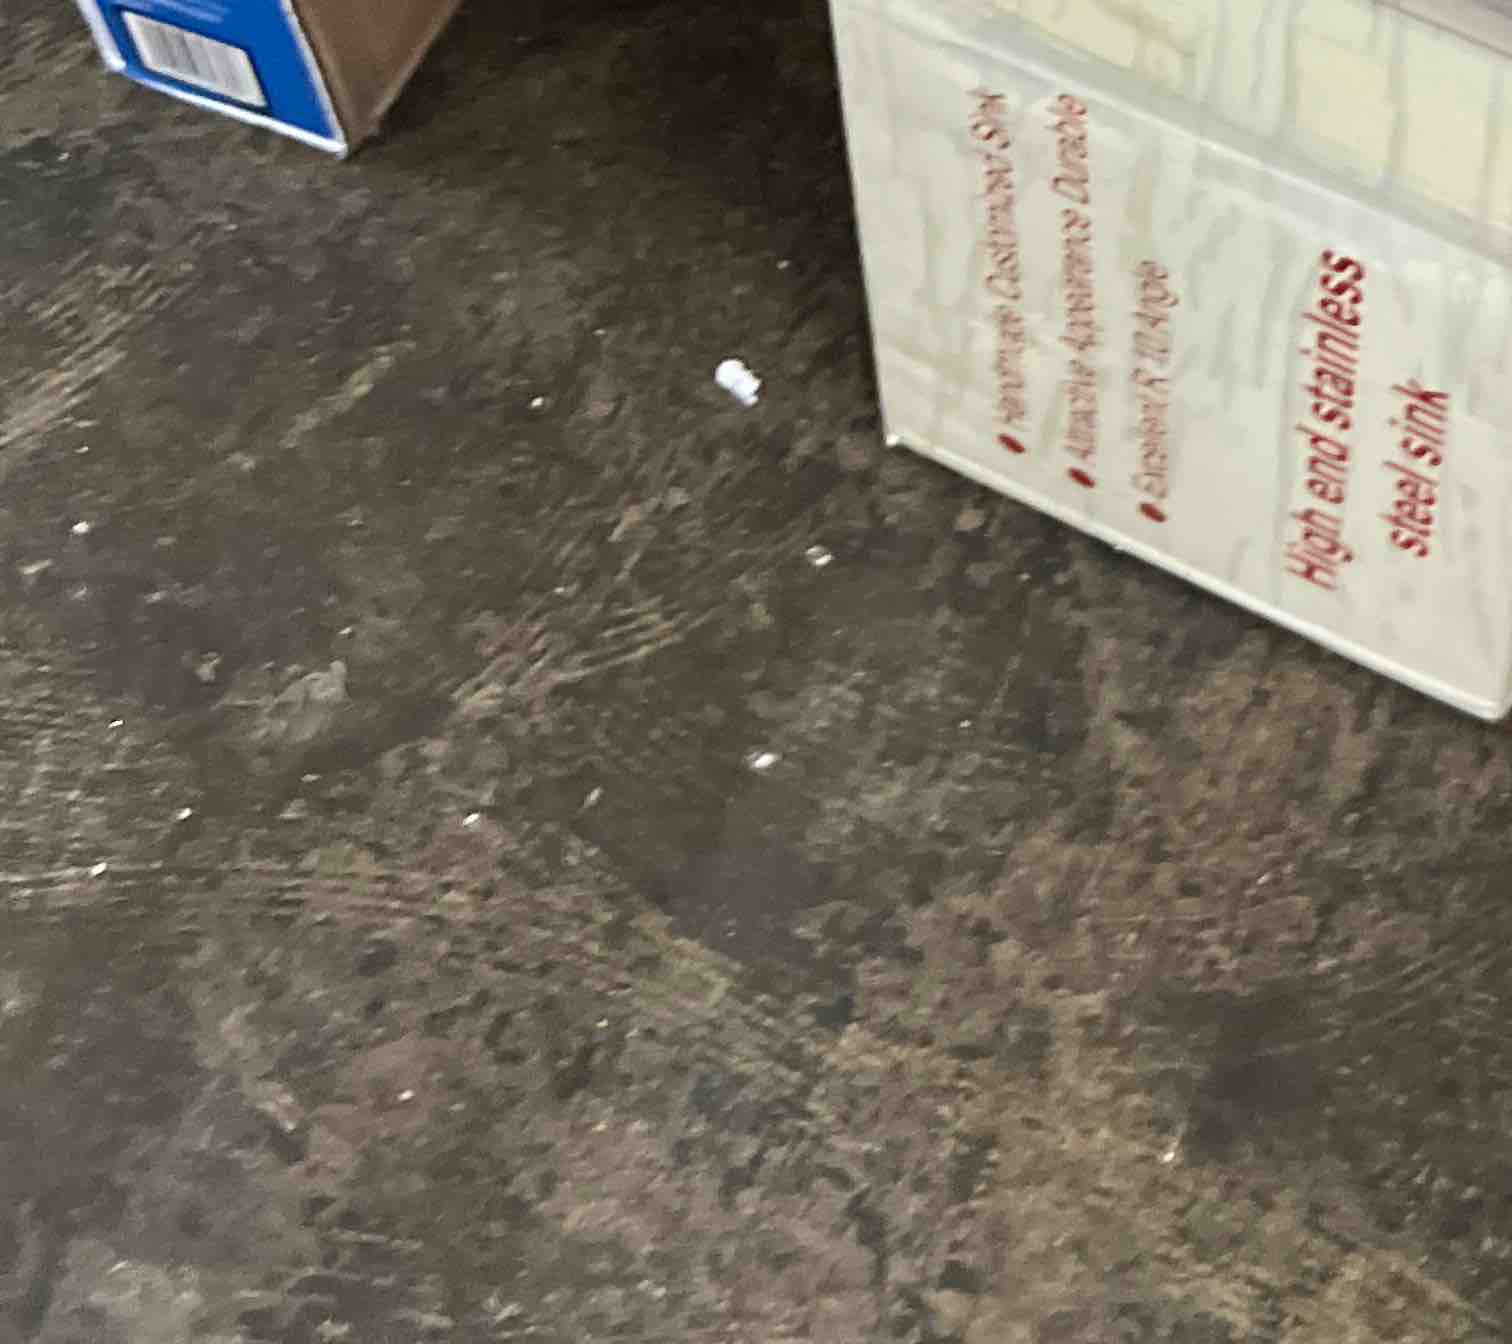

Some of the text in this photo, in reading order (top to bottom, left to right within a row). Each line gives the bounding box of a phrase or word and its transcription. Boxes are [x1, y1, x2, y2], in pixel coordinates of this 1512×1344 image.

[1284, 249, 1366, 592] High end stainless
[1378, 378, 1452, 559] steel sink
